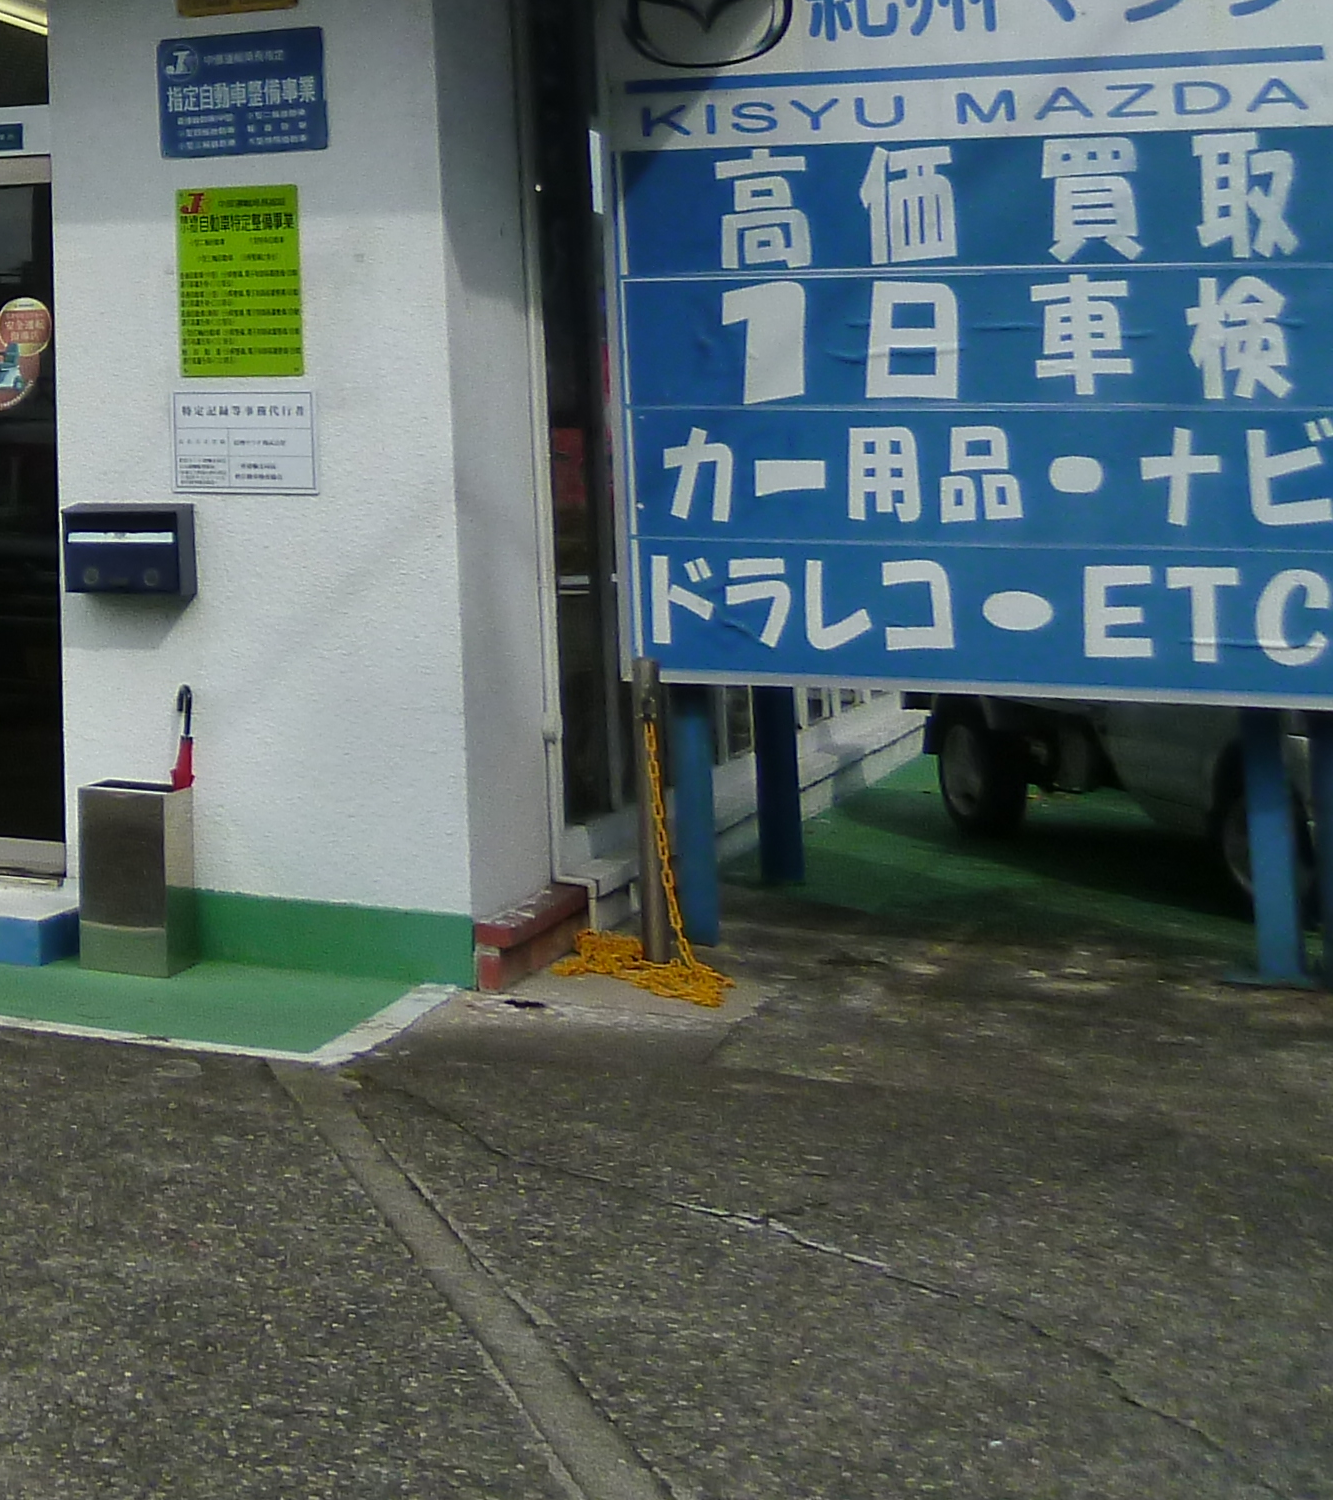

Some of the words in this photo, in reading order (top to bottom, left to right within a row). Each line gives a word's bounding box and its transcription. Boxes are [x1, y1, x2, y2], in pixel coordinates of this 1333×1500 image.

[166, 75, 316, 113] 指定自動車整備事業
[640, 96, 906, 138] KISYU
[955, 77, 1310, 126] MAZDA
[714, 131, 1300, 270] 高価買取
[721, 273, 1295, 405] 1日車検
[663, 418, 1333, 528] カー用品・ナビ
[649, 554, 1331, 667] ドラレコ・ETC
